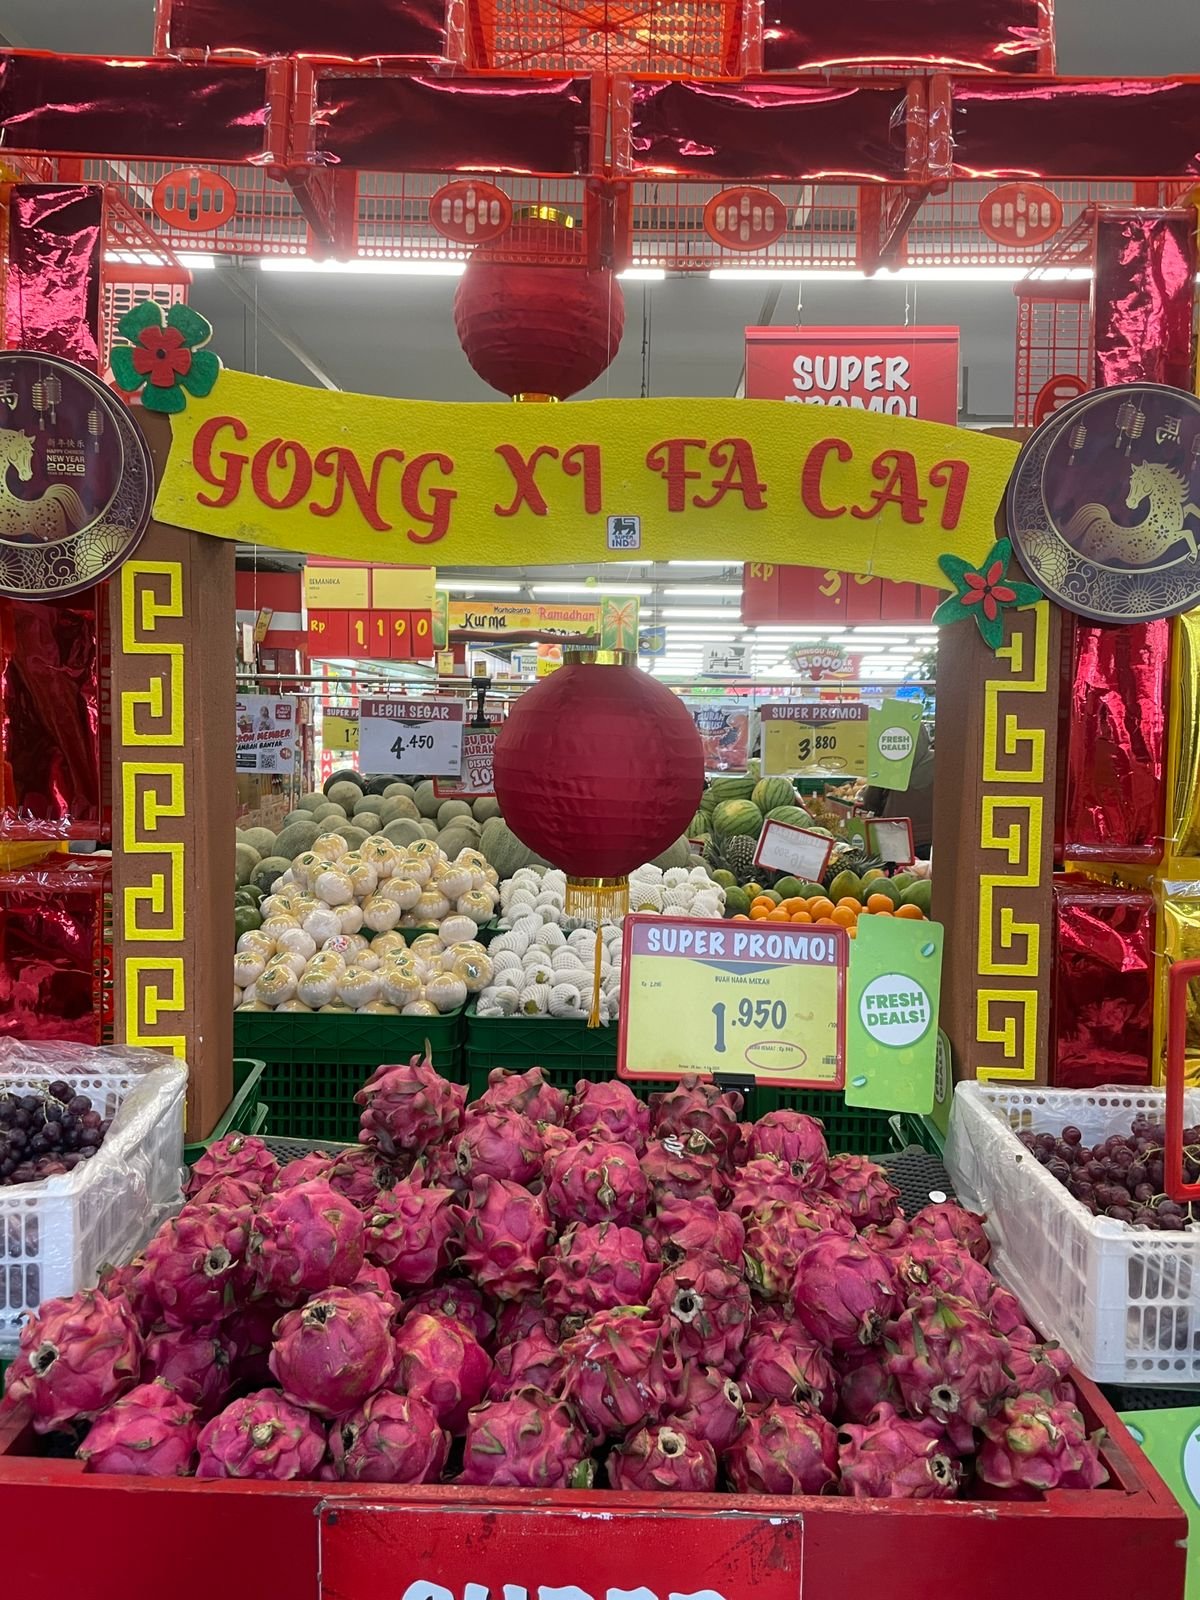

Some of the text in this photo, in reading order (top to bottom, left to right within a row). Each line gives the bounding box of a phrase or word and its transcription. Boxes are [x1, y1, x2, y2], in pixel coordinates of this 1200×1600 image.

[792, 355, 911, 392] SUPER
[46, 454, 85, 463] NEW YEAR
[47, 463, 86, 472] 2026
[192, 415, 971, 545] GONG XI FA CAI
[459, 613, 508, 629] Kurma
[538, 607, 596, 622] Ramadhan
[311, 620, 326, 634] Rp
[327, 708, 349, 716] SUPER
[371, 703, 450, 719] LEBIH SEGAR
[772, 707, 862, 719] SUPER PROMO!
[881, 735, 910, 743] FRESH
[390, 735, 434, 759] 4.450
[881, 743, 910, 751] DEALS!
[468, 758, 493, 769] DISKO
[647, 927, 835, 963] SUPER PROMO!
[865, 992, 924, 1009] FRESH
[712, 997, 787, 1053] 1.950
[866, 1009, 926, 1026] DEALS!
